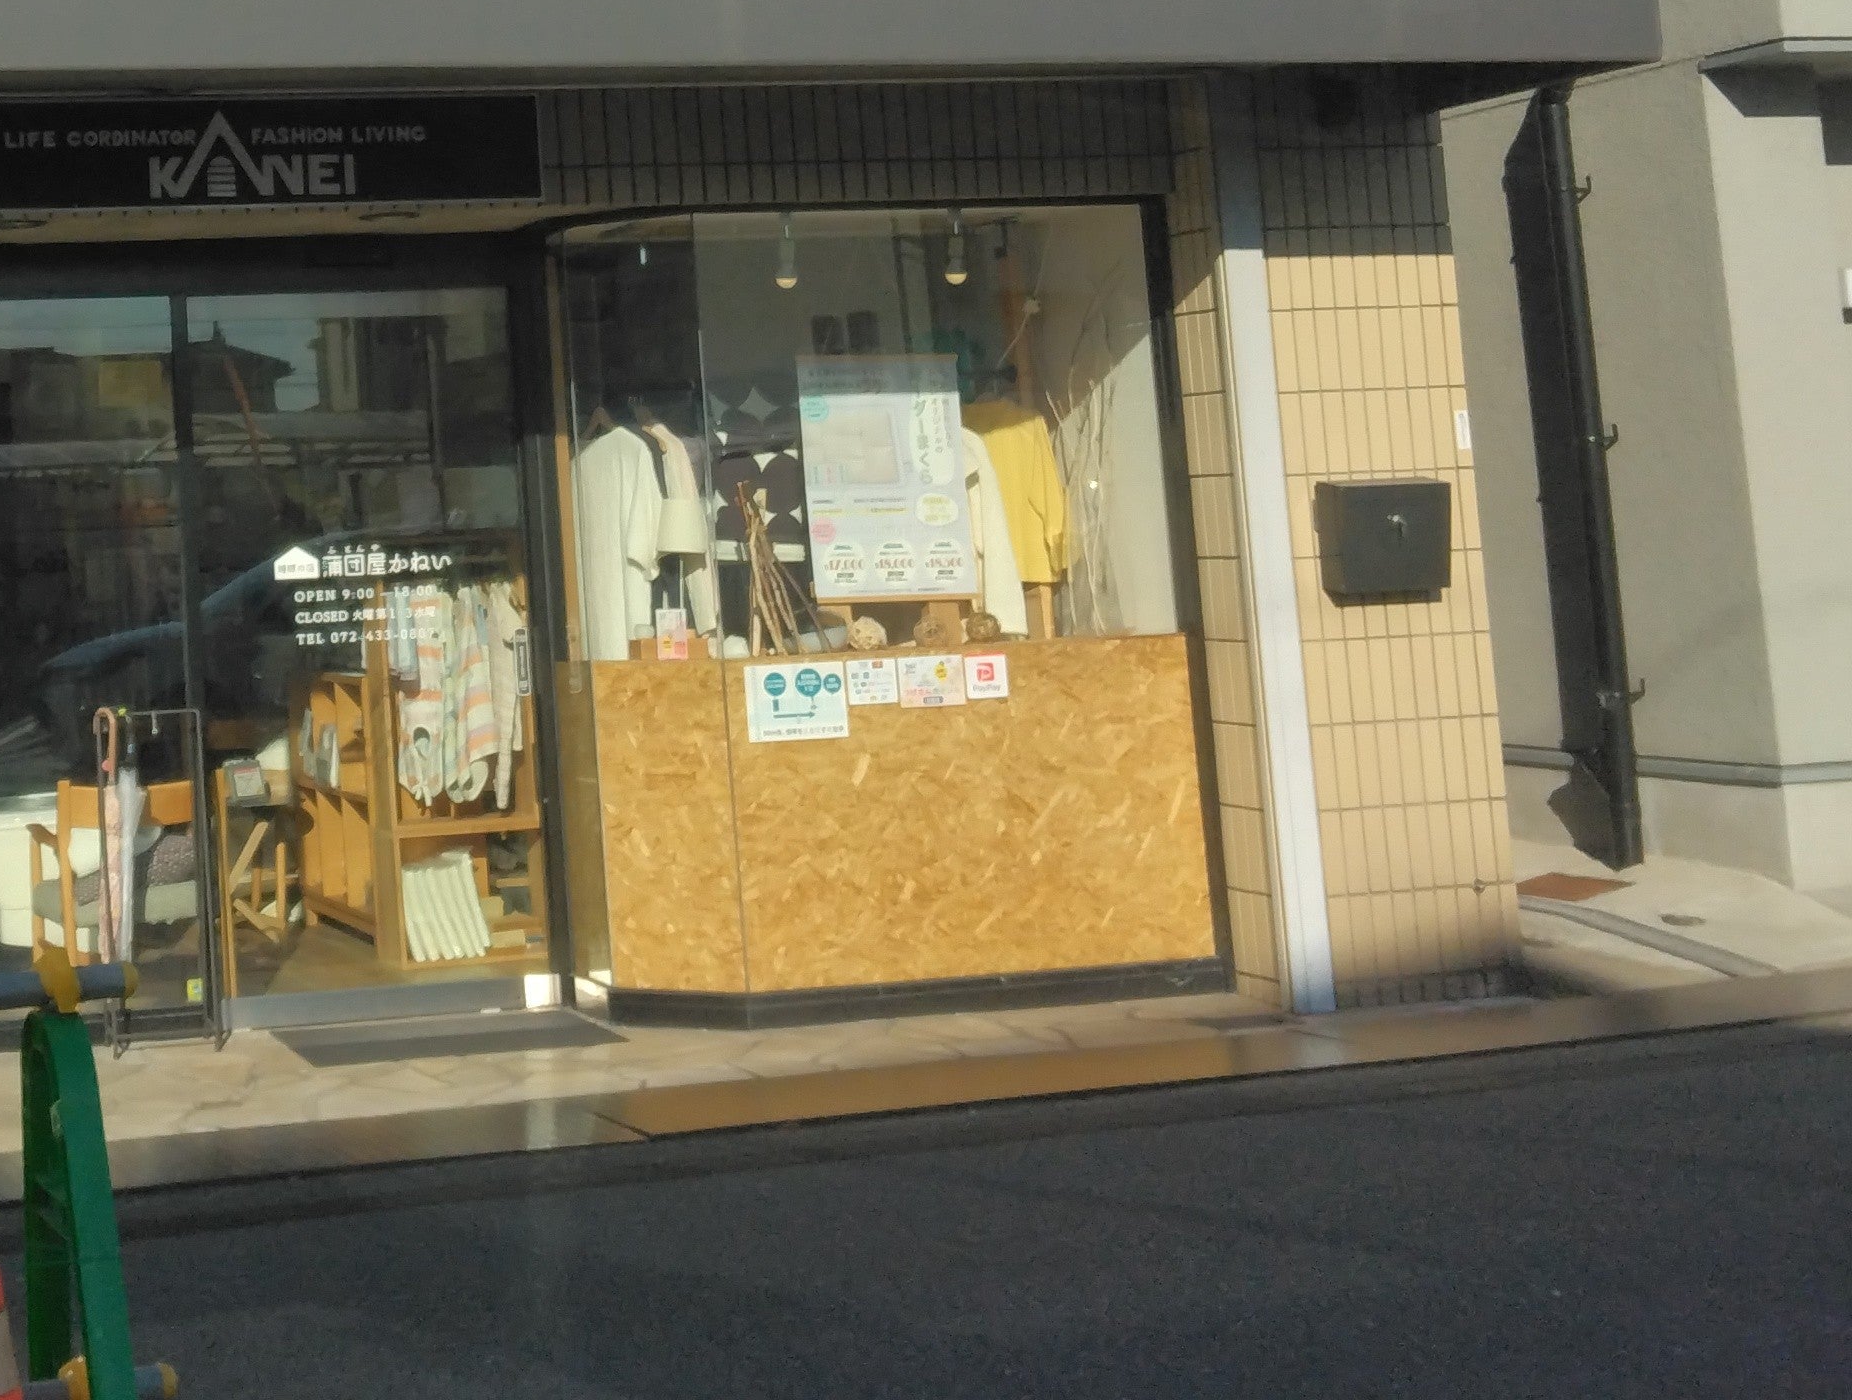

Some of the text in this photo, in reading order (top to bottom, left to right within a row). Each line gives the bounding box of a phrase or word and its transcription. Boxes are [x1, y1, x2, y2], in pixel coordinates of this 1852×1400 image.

[3, 130, 56, 149] LIFE
[251, 125, 427, 145] FASHION LIVING
[148, 109, 357, 200] KANEI
[294, 590, 336, 603] OPEN
[295, 610, 349, 624] CLOSED
[295, 632, 326, 646] TEL
